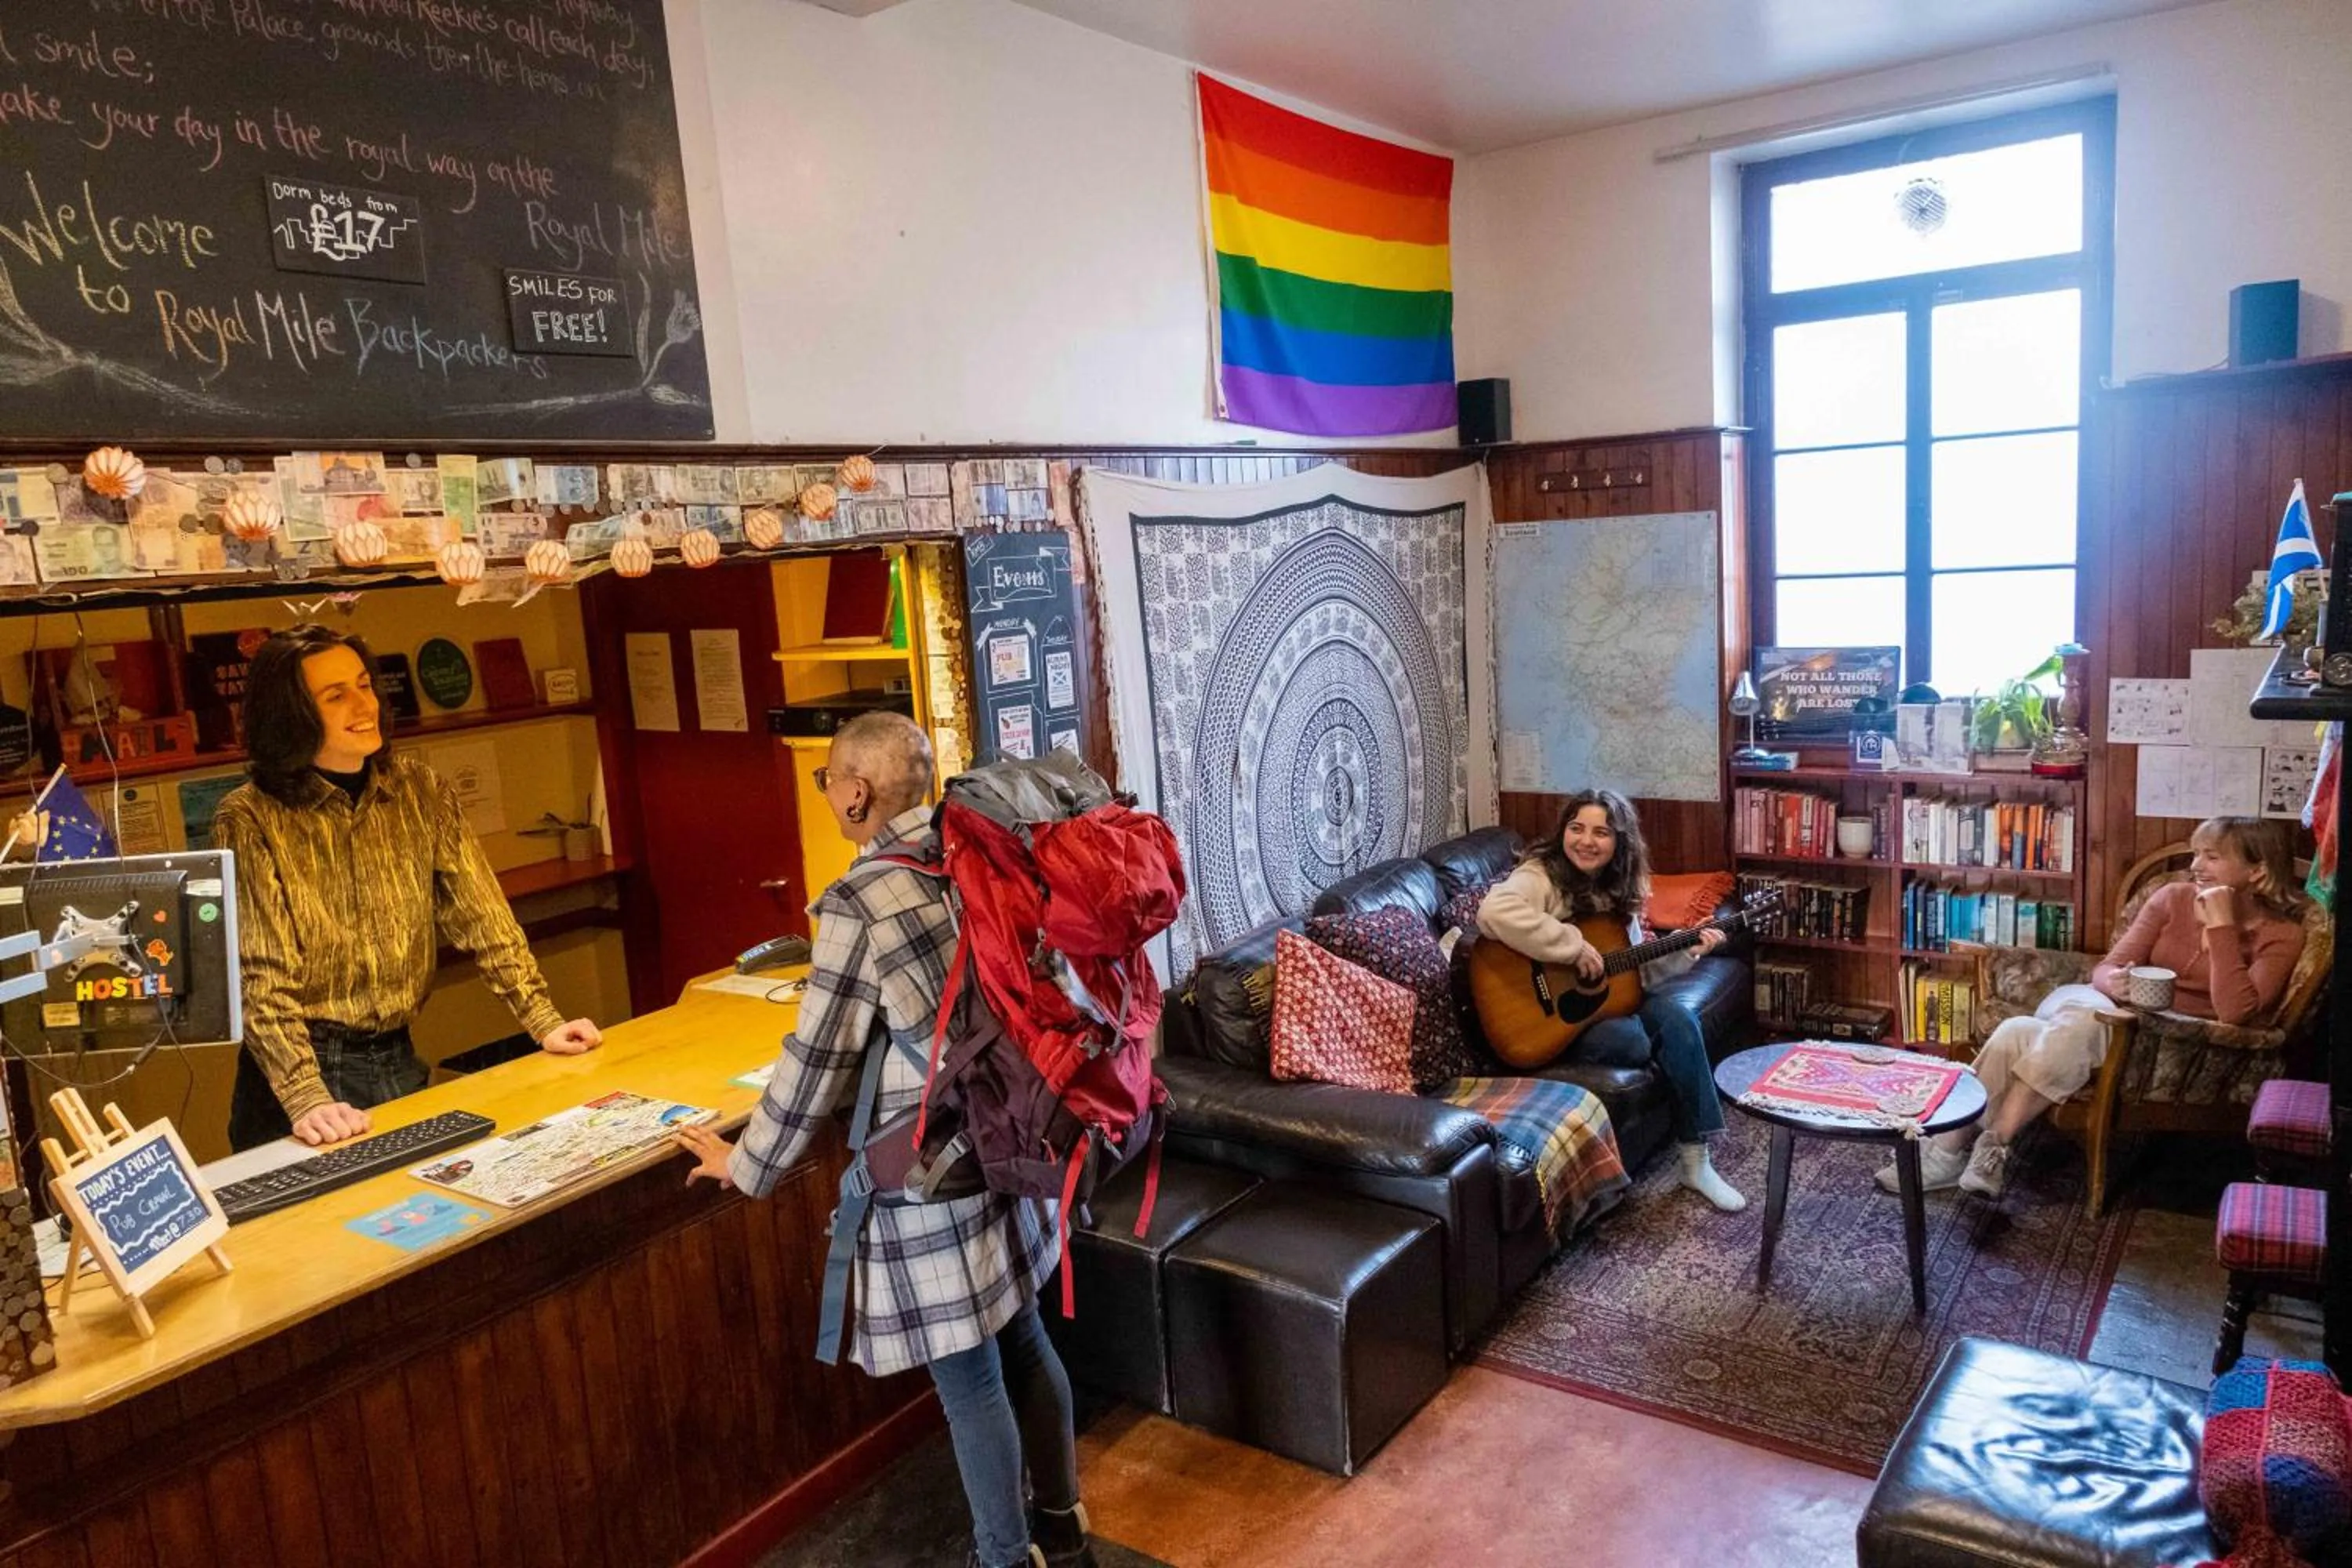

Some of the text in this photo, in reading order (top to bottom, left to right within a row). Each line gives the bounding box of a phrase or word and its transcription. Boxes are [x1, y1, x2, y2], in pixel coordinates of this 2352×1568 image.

[321, 22, 416, 62] grounds
[0, 83, 75, 124] ake
[78, 101, 159, 151] your
[174, 105, 223, 172] day
[235, 110, 267, 151] in
[274, 105, 333, 161] the
[345, 132, 421, 182] royal
[426, 153, 477, 215] way
[272, 181, 399, 214] Dorm beds from
[0, 169, 221, 270] Welcome
[310, 203, 386, 261] £17
[524, 200, 691, 271] Royal Mile
[77, 263, 131, 314] to
[589, 286, 618, 306] FOR
[154, 289, 549, 383] Royal Mile Backpackers
[532, 308, 608, 343] FREE!
[1780, 672, 1883, 682] NOT ALL THOSE
[1786, 684, 1878, 695] WHO WANDER
[1798, 699, 1825, 708] ARE
[79, 724, 176, 764] MAIL
[76, 973, 173, 1001] HOSTEL
[78, 1165, 126, 1205] TODAY'S
